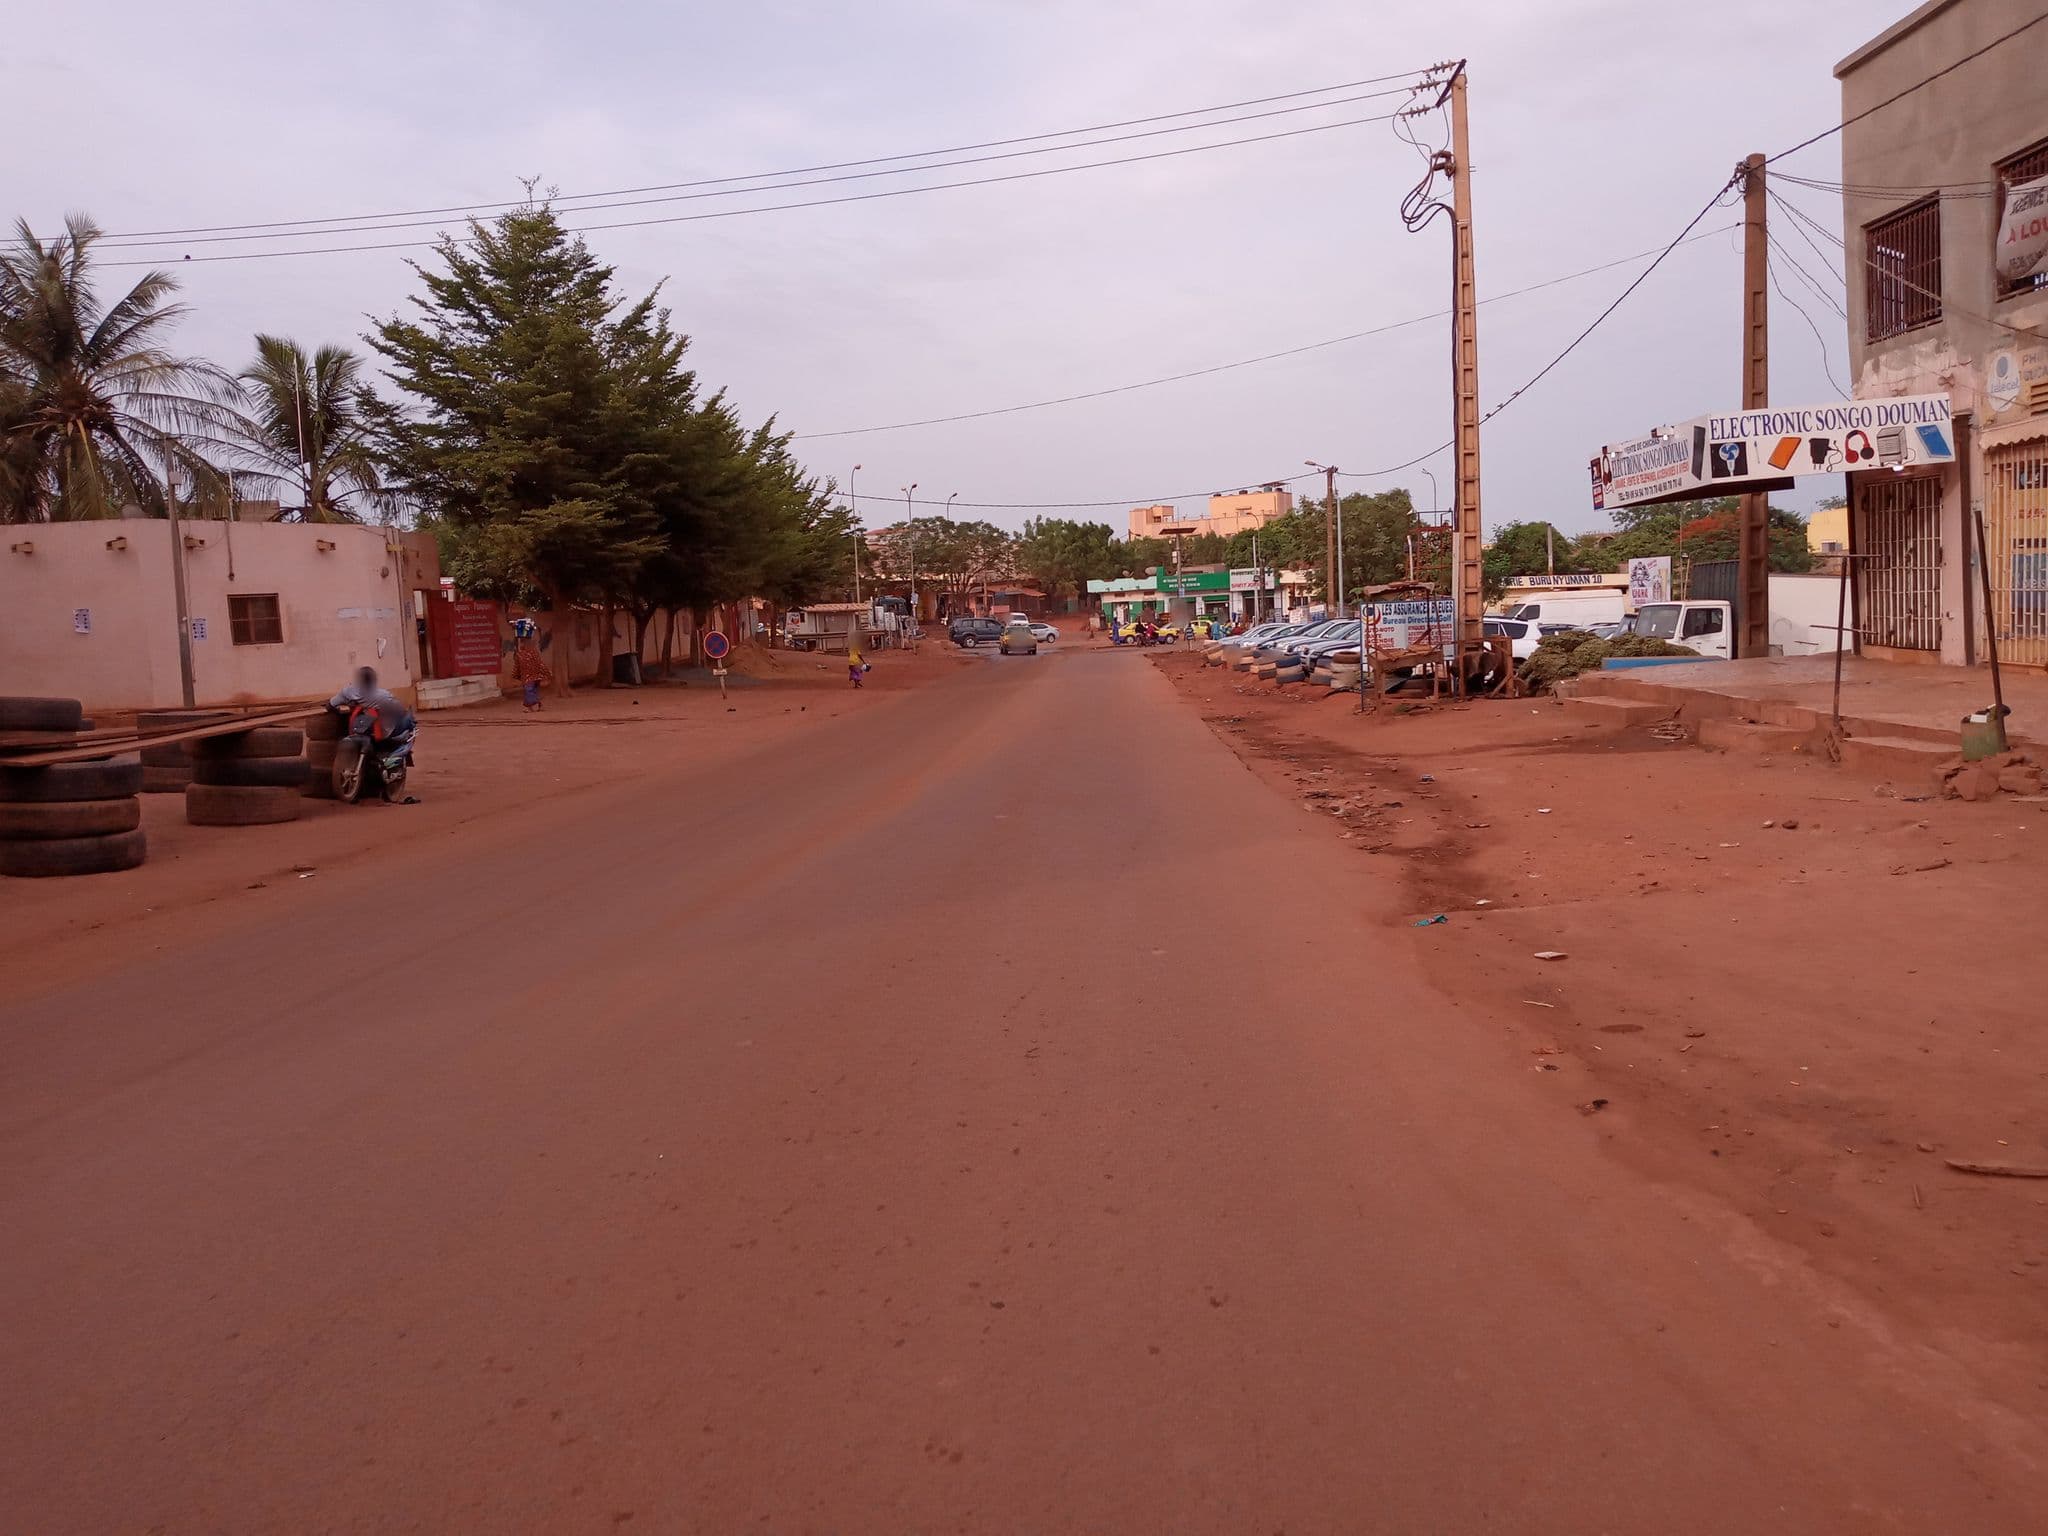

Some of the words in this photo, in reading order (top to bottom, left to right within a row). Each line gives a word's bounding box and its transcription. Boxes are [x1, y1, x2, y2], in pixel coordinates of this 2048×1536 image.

[1710, 411, 1812, 440] ELECTRONIC
[1816, 406, 1872, 430] SONGO
[1876, 399, 1950, 426] DOUMAN
[1529, 575, 1551, 586] BURU
[1591, 574, 1602, 584] 10
[1382, 603, 1392, 616] LES
[1394, 602, 1429, 616] ASSURANCE
[1431, 600, 1453, 614] BEUES
[1383, 617, 1406, 625] Bureau
